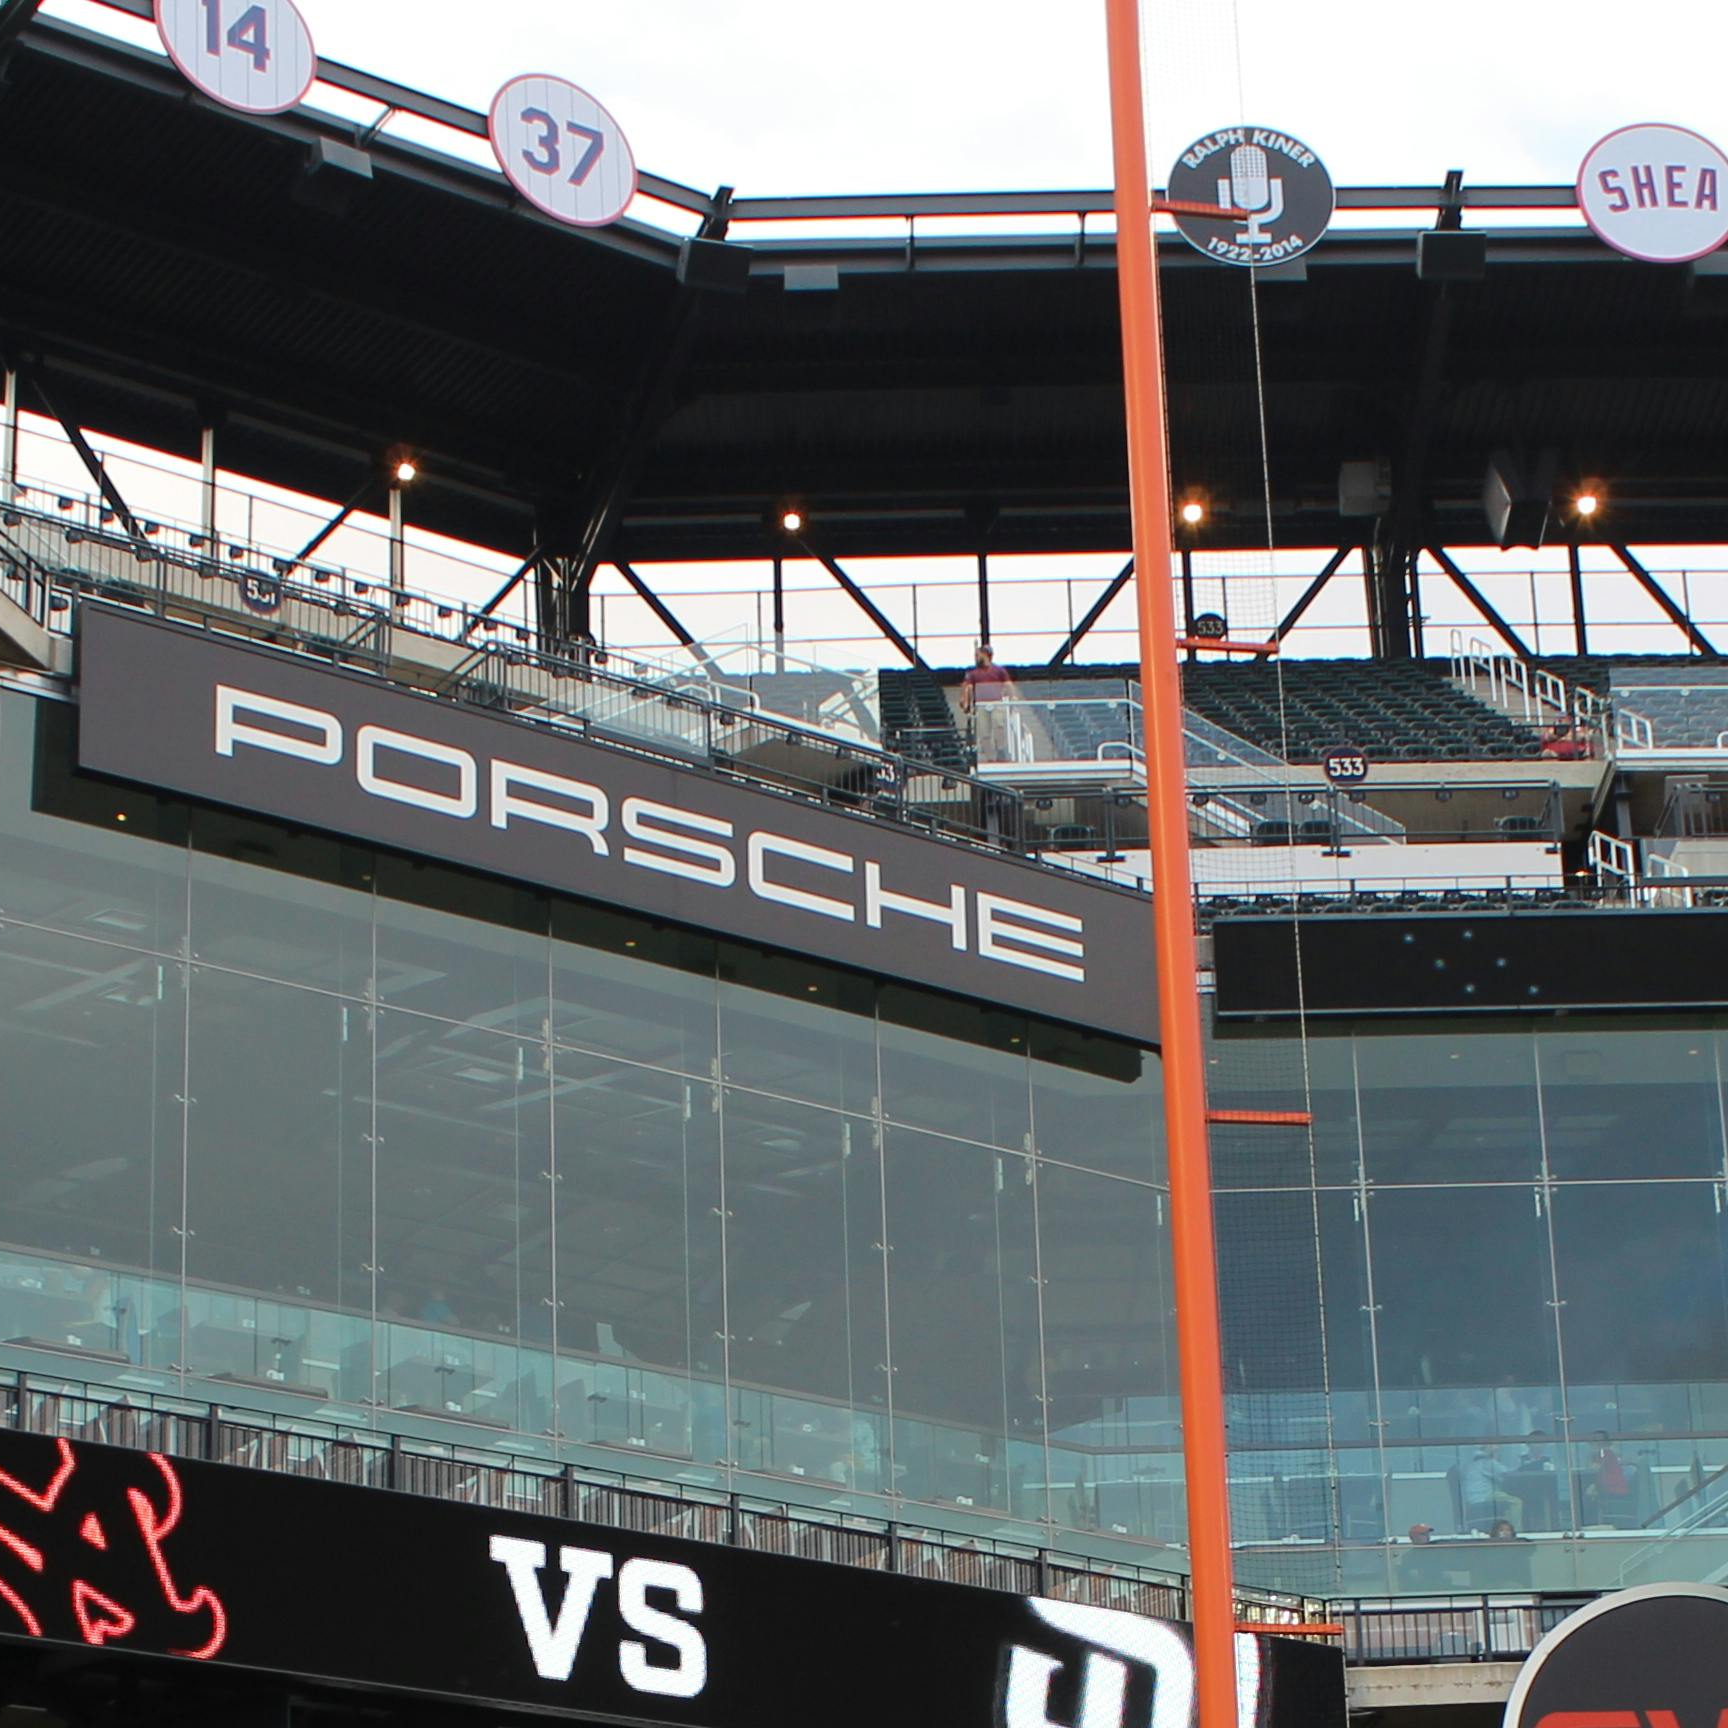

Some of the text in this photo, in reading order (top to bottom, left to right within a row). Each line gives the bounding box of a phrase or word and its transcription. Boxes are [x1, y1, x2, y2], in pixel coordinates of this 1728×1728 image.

[201, 0, 271, 73] 14
[520, 106, 605, 187] 37
[1181, 129, 1316, 169] RALPH KINER
[1597, 164, 1718, 213] SHEA
[1207, 234, 1304, 262] 1922-2014
[1328, 757, 1364, 777] 533
[215, 683, 1085, 982] PORSCHE
[489, 1534, 707, 1699] VS
